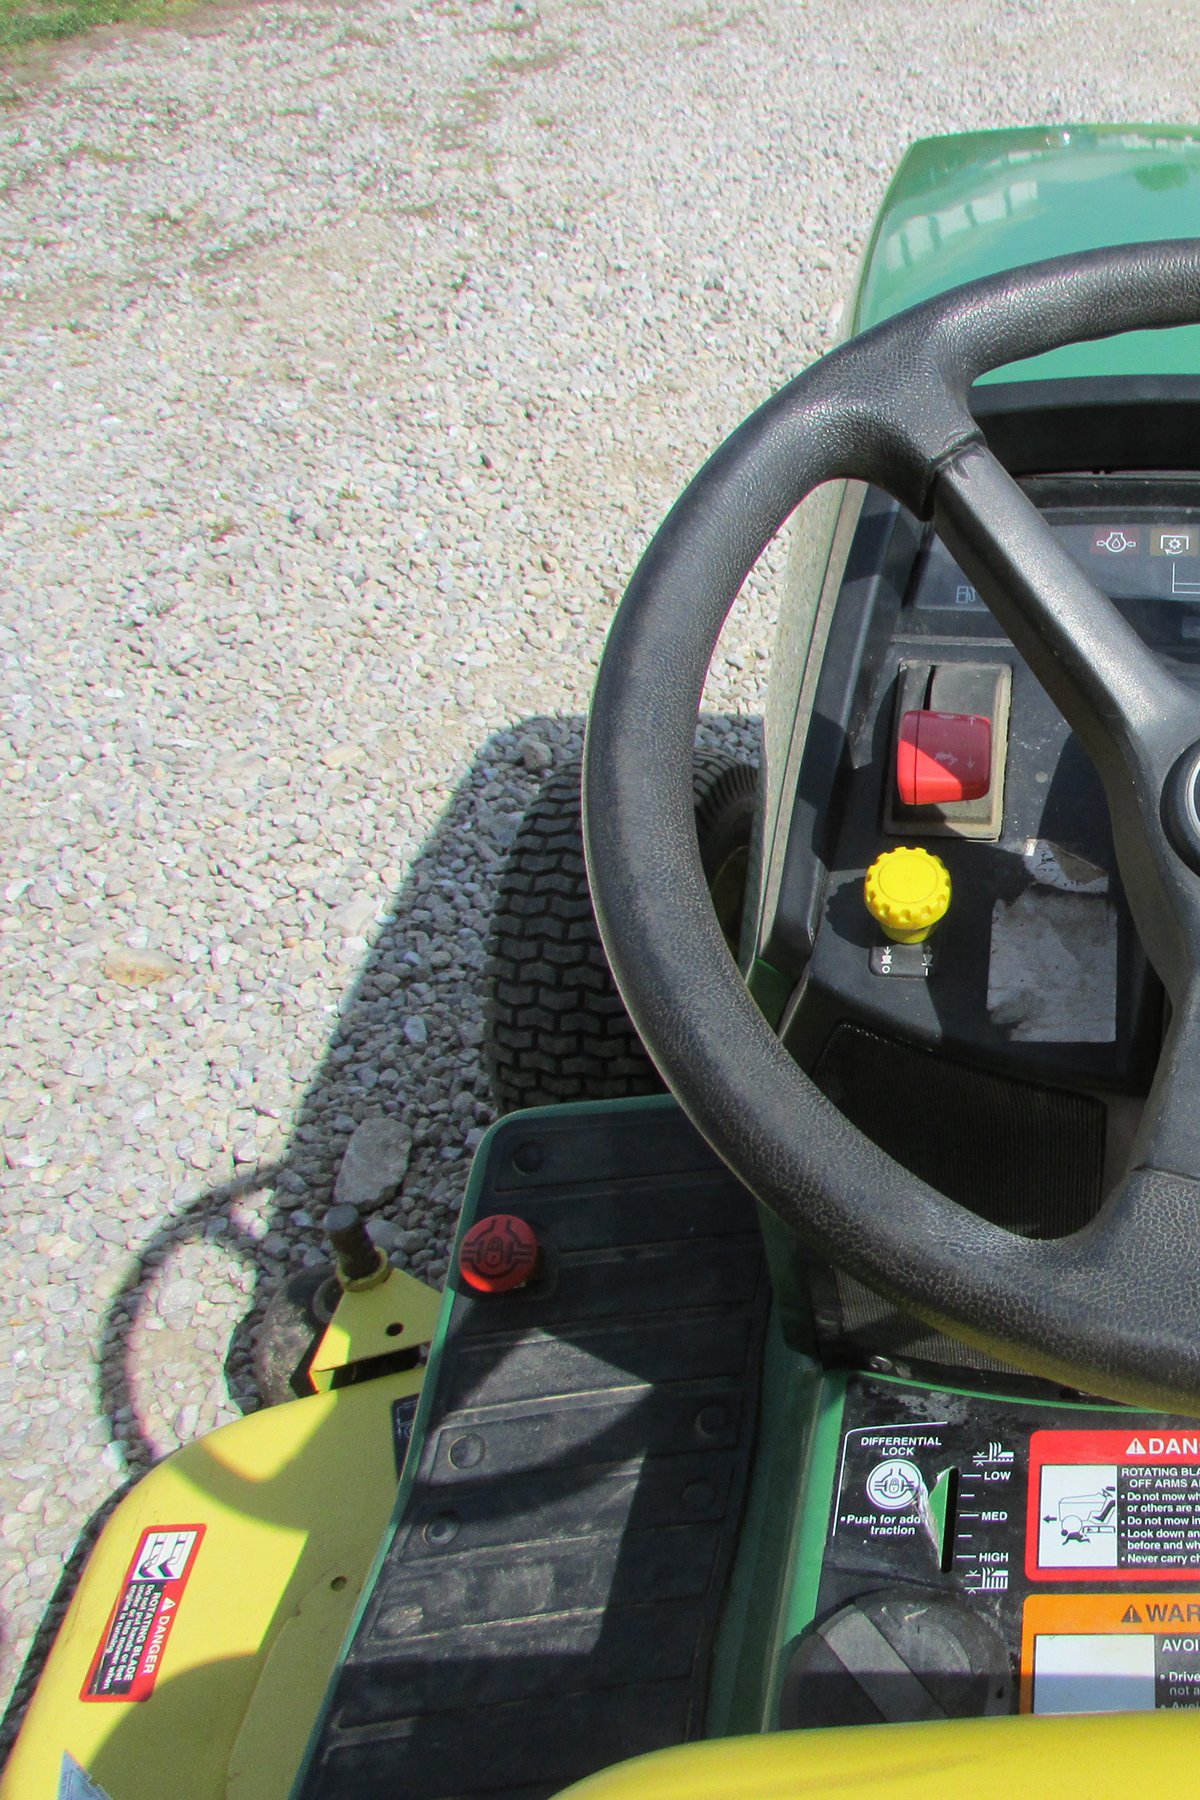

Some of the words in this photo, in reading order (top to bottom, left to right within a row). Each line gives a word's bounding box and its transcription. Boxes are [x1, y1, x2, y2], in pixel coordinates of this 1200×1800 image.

[861, 1437, 942, 1446] DIFFERENTIAL
[882, 1447, 915, 1456] LOCK
[984, 1471, 1011, 1481] LOW
[1121, 1467, 1178, 1477] ROTATING
[1129, 1479, 1152, 1488] OFF
[1155, 1479, 1187, 1488] ARMS
[1127, 1492, 1141, 1500] Do
[1140, 1504, 1173, 1512] others
[847, 1515, 877, 1524] Push
[880, 1515, 896, 1524] for
[981, 1512, 1008, 1521] MED
[1128, 1516, 1142, 1525] Do
[1145, 1517, 1161, 1525] not
[1192, 1516, 1200, 1524] in
[870, 1526, 915, 1535] traction
[1128, 1529, 1153, 1538] Look
[1156, 1529, 1184, 1538] down
[1128, 1541, 1160, 1550] before
[1164, 1541, 1182, 1550] and
[979, 1553, 1009, 1562] HIGH
[1128, 1554, 1158, 1563] Never
[1161, 1554, 1187, 1564] carry
[135, 1592, 161, 1642] ROTATING
[141, 1615, 170, 1673] DANGER
[123, 1645, 143, 1680] BLADE
[1169, 1672, 1200, 1682] Drive
[1170, 1687, 1189, 1695] not
